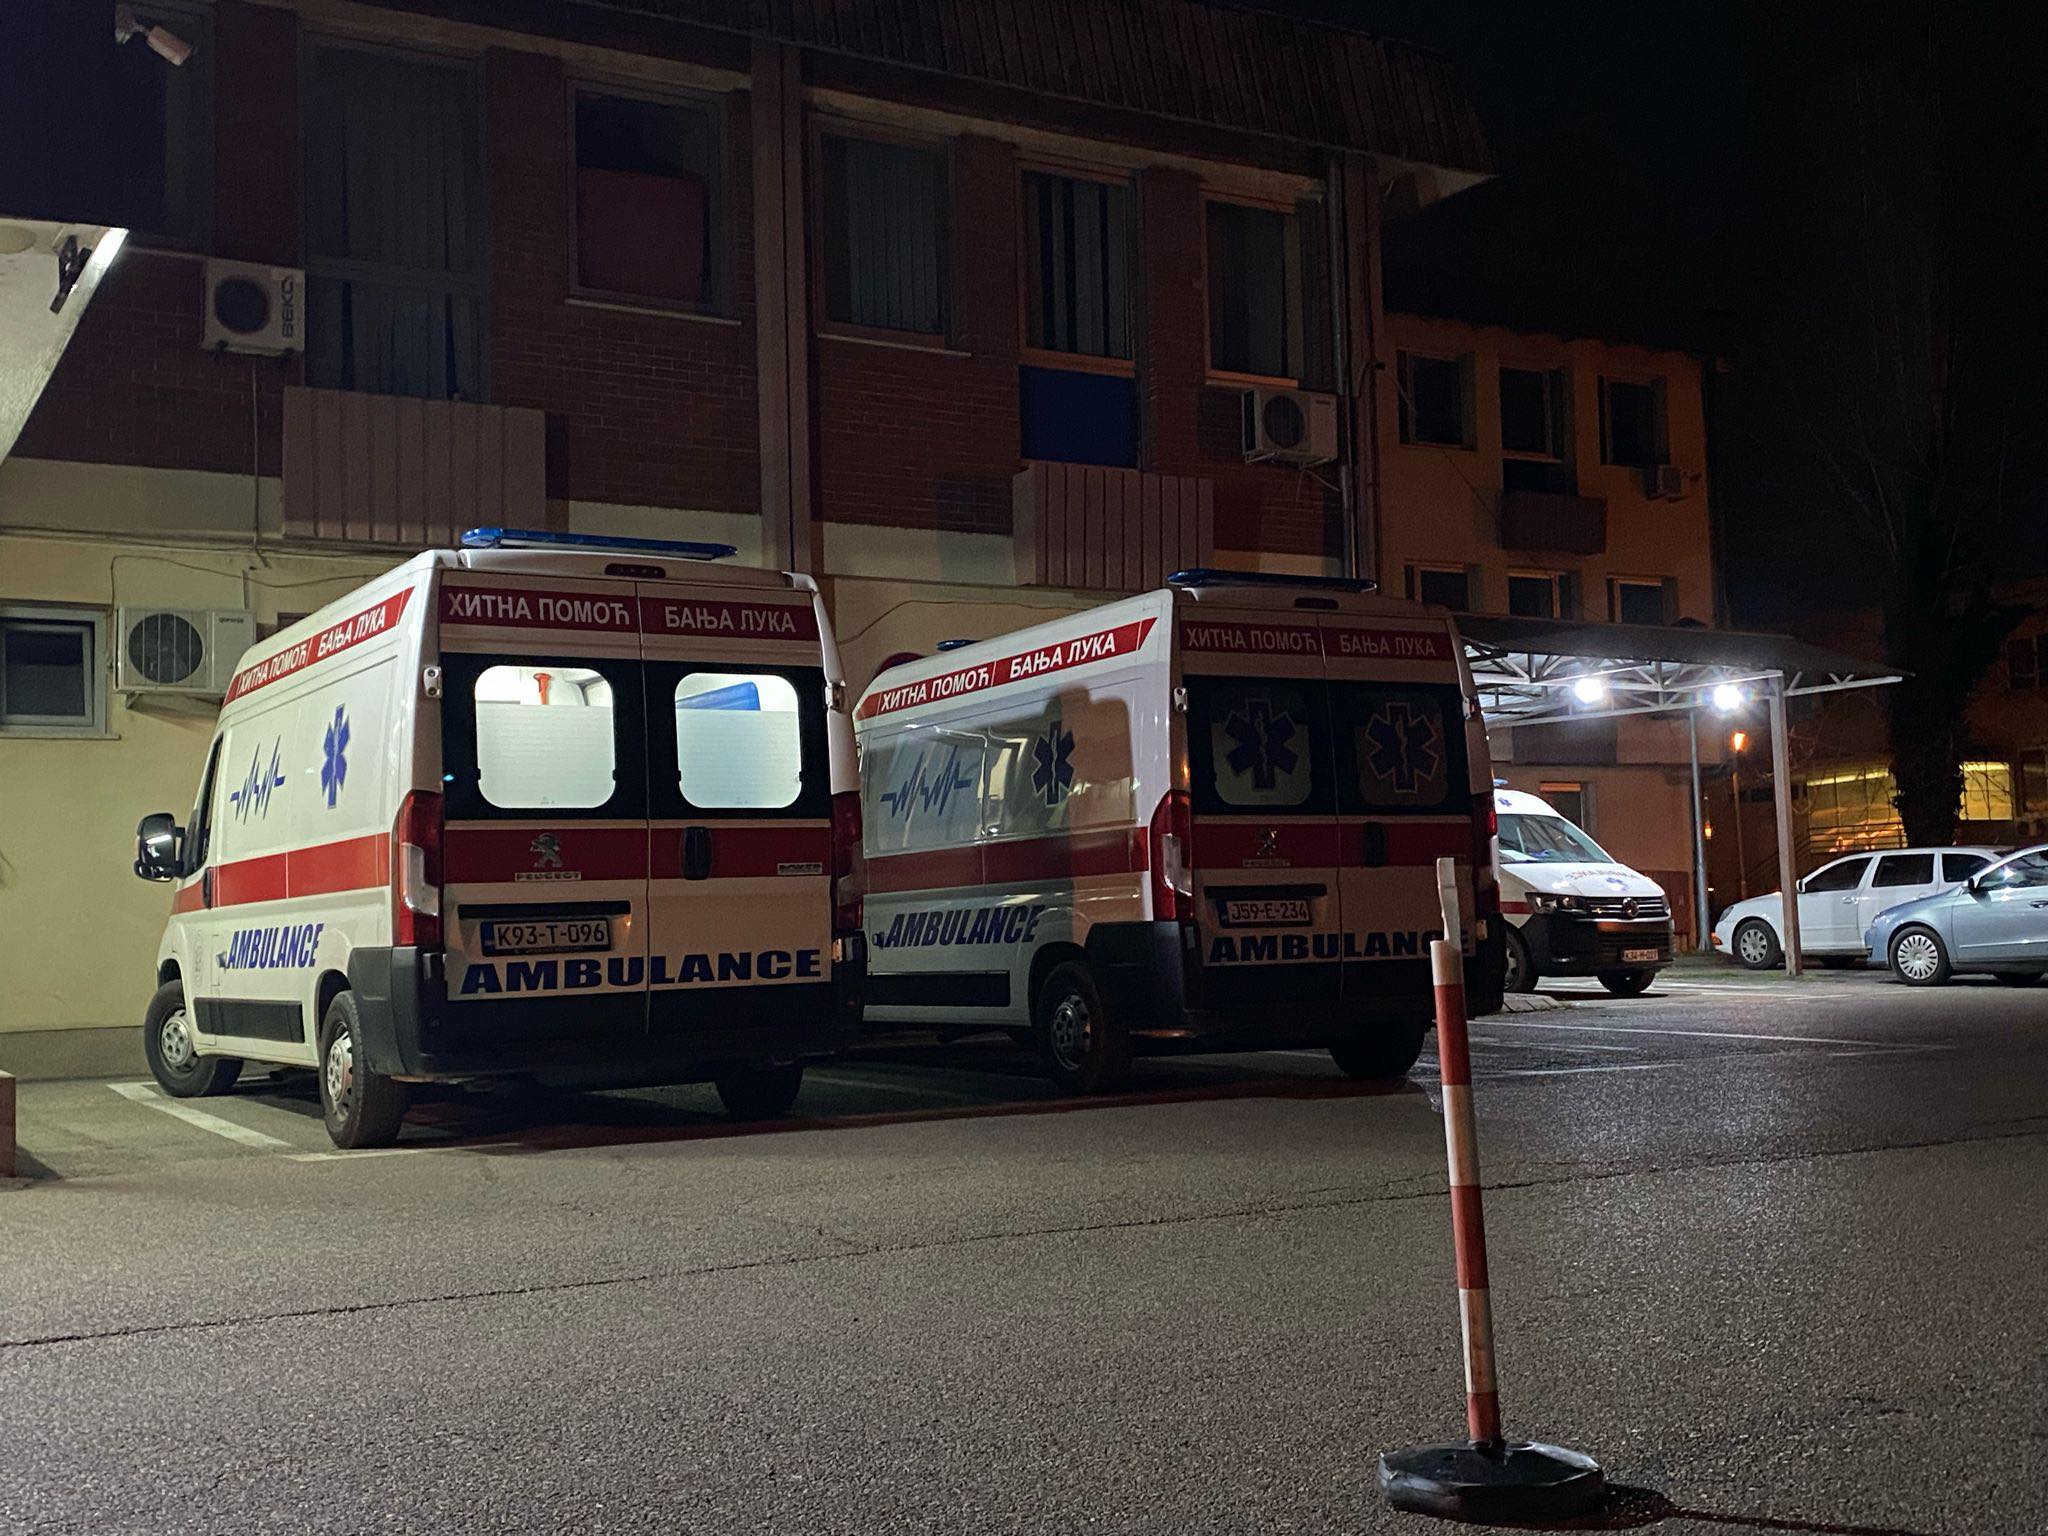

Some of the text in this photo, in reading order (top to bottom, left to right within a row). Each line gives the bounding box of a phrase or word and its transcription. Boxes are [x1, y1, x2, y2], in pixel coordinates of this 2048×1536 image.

[281, 276, 294, 337] BEKO
[317, 605, 387, 658] БАЊА ЛУКА
[447, 593, 630, 626] ХИТНА ПОМОЋ
[664, 605, 796, 633] БАЊА ЛУКА
[1009, 632, 1116, 679] БАЊА ЛУКА
[1185, 627, 1318, 651] ХИТНА ПОМОЋ
[1339, 633, 1437, 657] БАЊА ЛУКА
[239, 640, 307, 694] ХИТНА ПОМОЋ
[881, 666, 989, 712] ХИТНА ПОМОЋ
[226, 923, 325, 970] AMBULANCE
[497, 923, 605, 947] K93-T-096
[884, 904, 1046, 948] AMBULANCE
[460, 949, 822, 995] AMBULANCE
